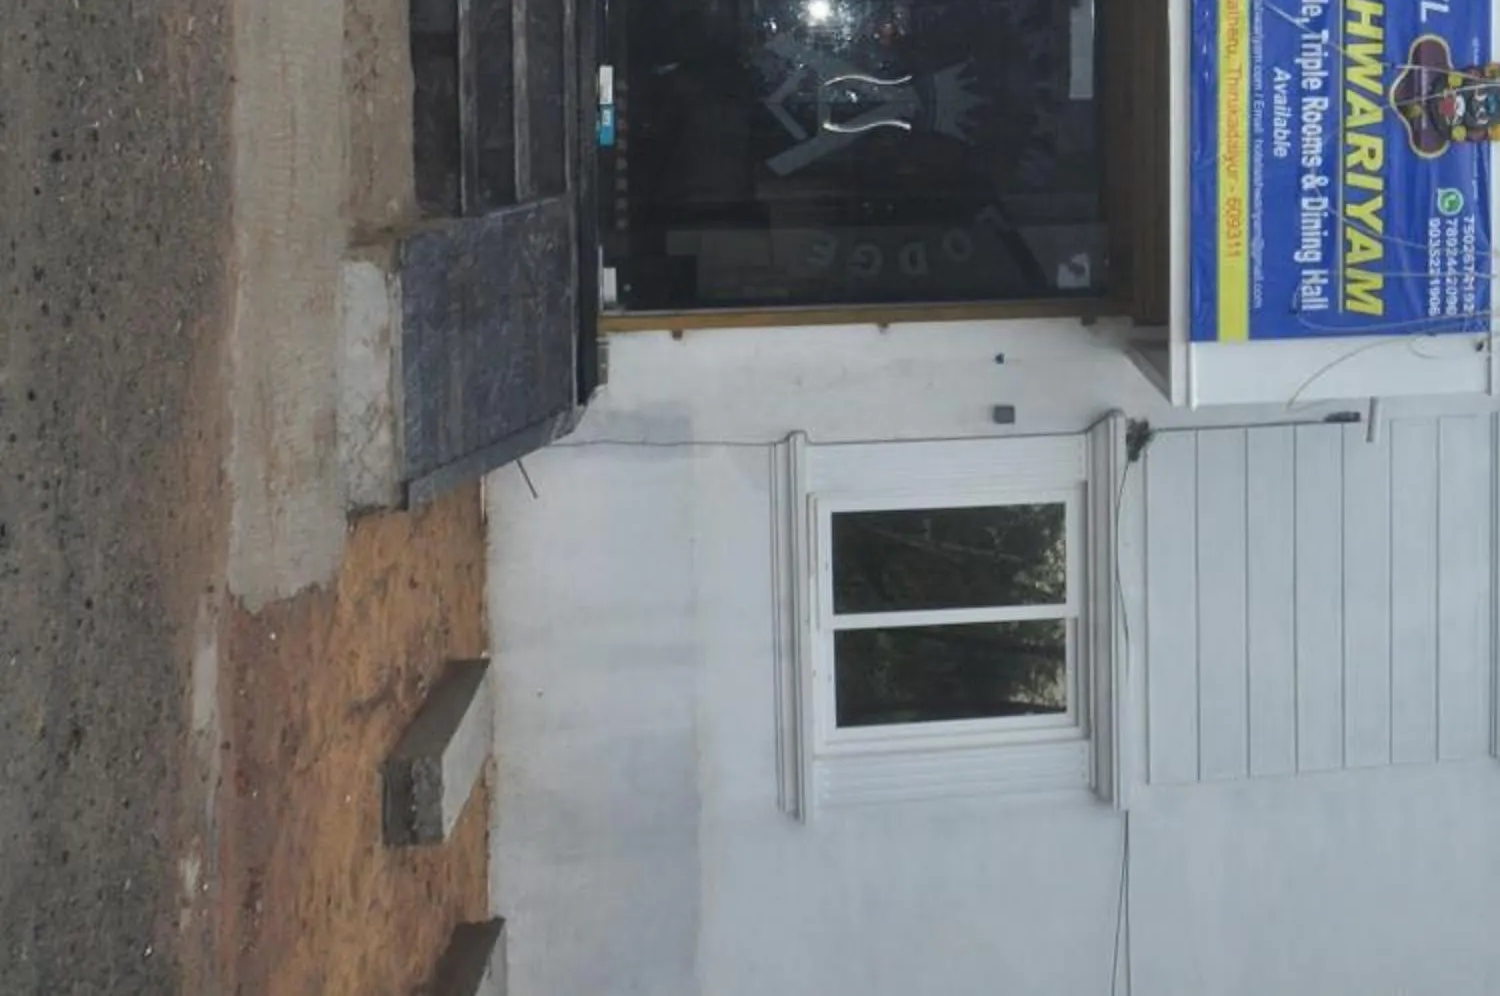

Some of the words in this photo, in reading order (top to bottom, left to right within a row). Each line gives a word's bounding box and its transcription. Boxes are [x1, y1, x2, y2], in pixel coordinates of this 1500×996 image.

[1295, 30, 1329, 90] Triple
[1273, 67, 1292, 158] Available
[1301, 96, 1329, 167] Rooms
[1301, 173, 1329, 191] &
[1294, 196, 1329, 263] Dining
[1301, 269, 1329, 310] Hall
